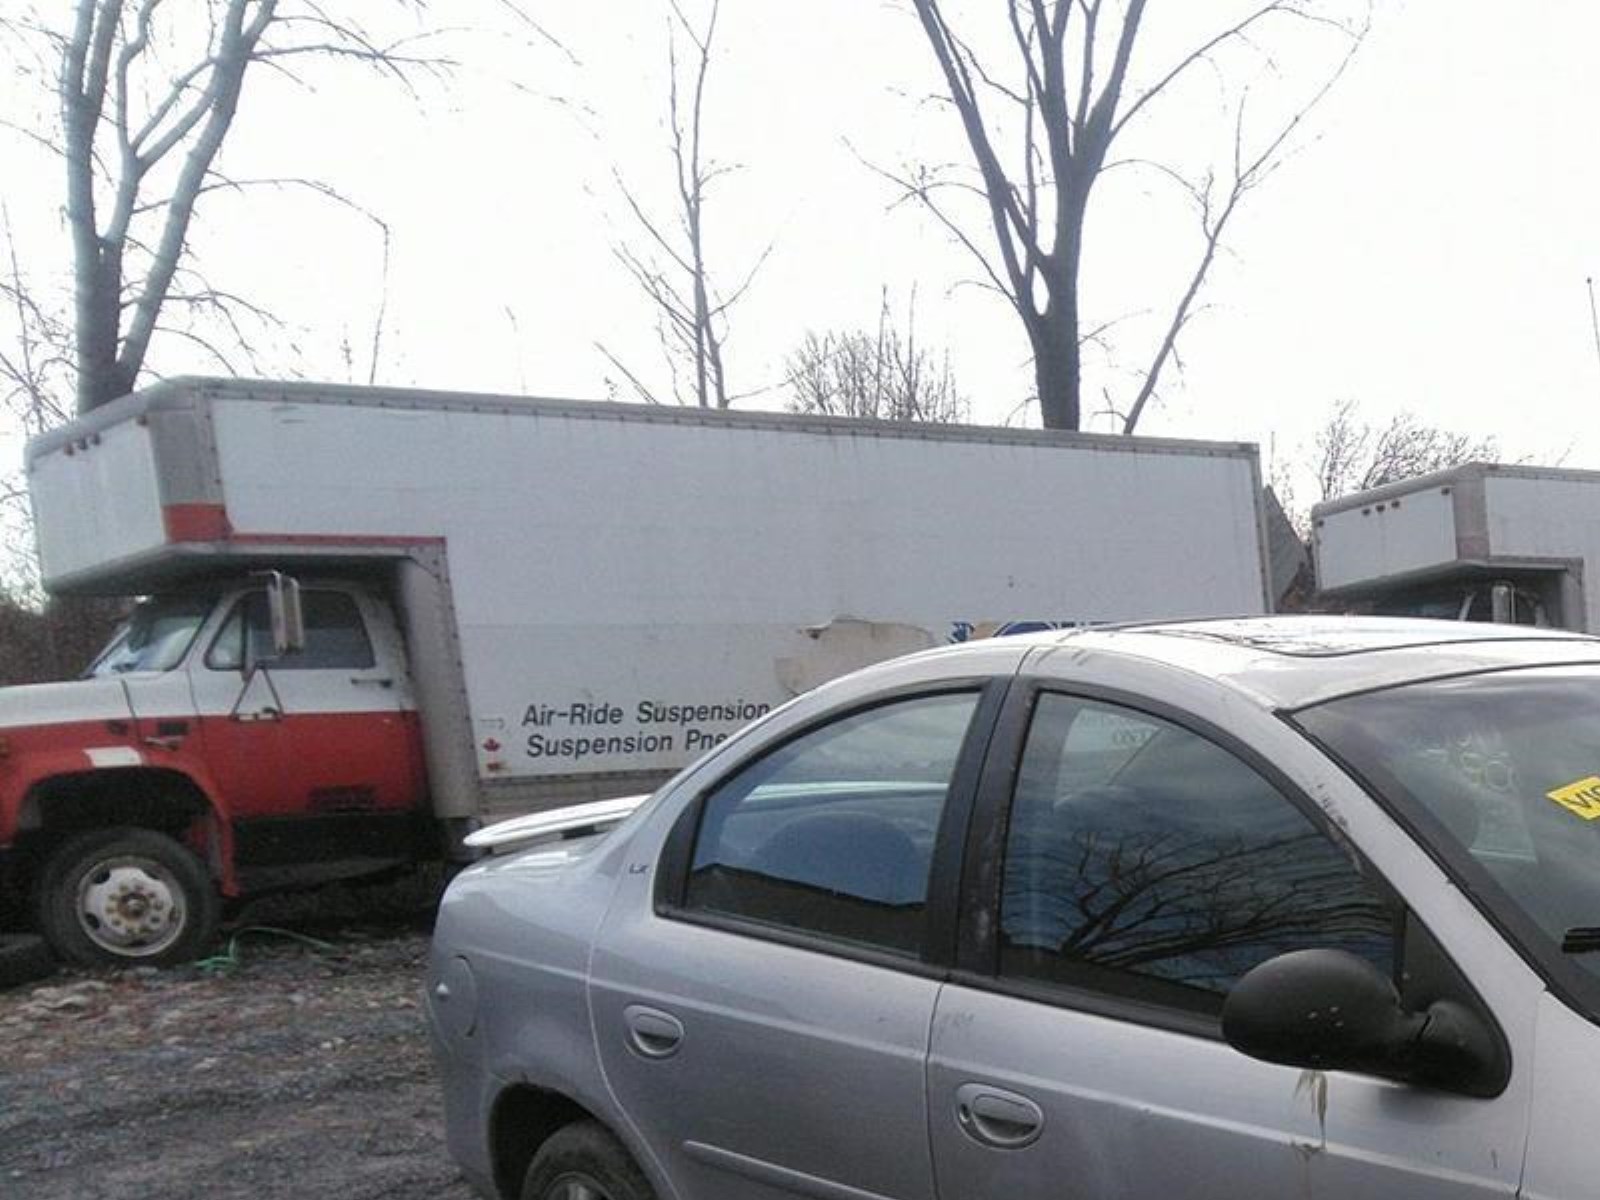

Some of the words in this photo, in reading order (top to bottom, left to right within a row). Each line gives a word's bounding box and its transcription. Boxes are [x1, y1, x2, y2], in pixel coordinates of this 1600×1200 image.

[521, 702, 624, 727] Air-Ride
[636, 699, 771, 727] Suspension
[526, 730, 673, 759] Suspension
